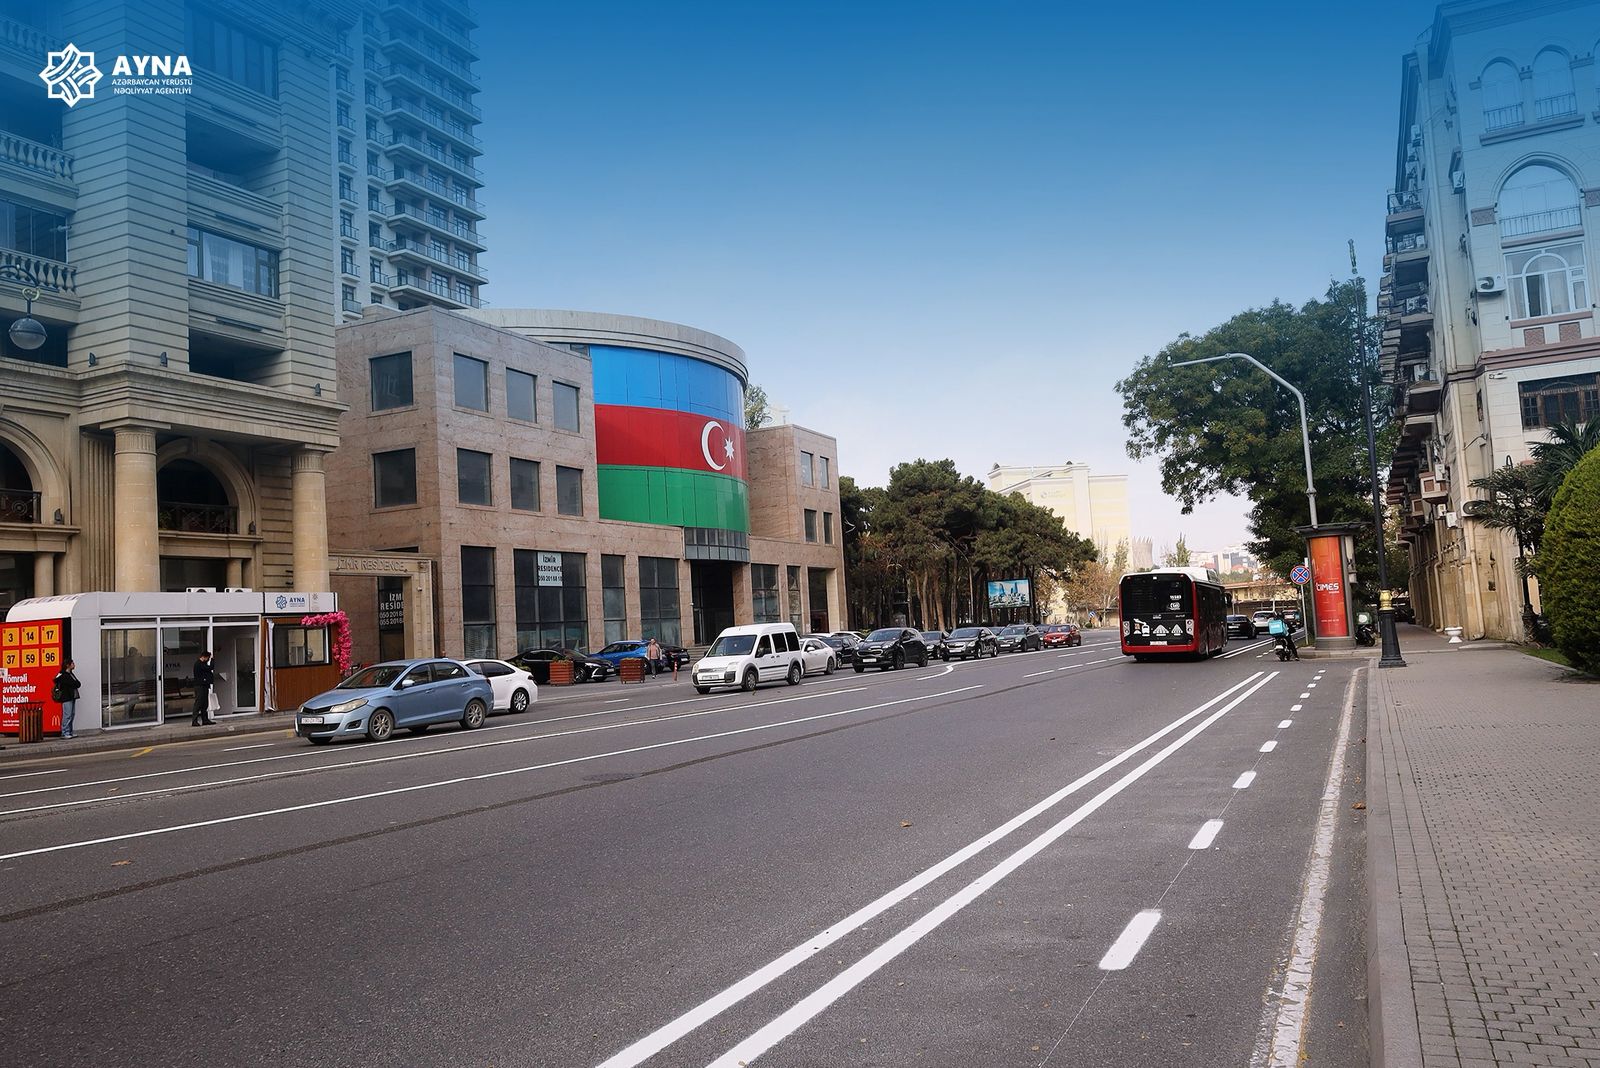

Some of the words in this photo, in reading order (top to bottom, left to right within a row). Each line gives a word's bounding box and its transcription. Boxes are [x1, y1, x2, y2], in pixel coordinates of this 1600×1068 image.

[8, 633, 13, 643] 3
[26, 632, 34, 641] 14
[46, 630, 54, 640] 17
[6, 655, 15, 664] 37
[26, 654, 35, 664] 59
[45, 653, 55, 663] 96
[3, 684, 37, 694] avtobuslar
[3, 695, 29, 704] buradan
[3, 704, 18, 717] keçir
